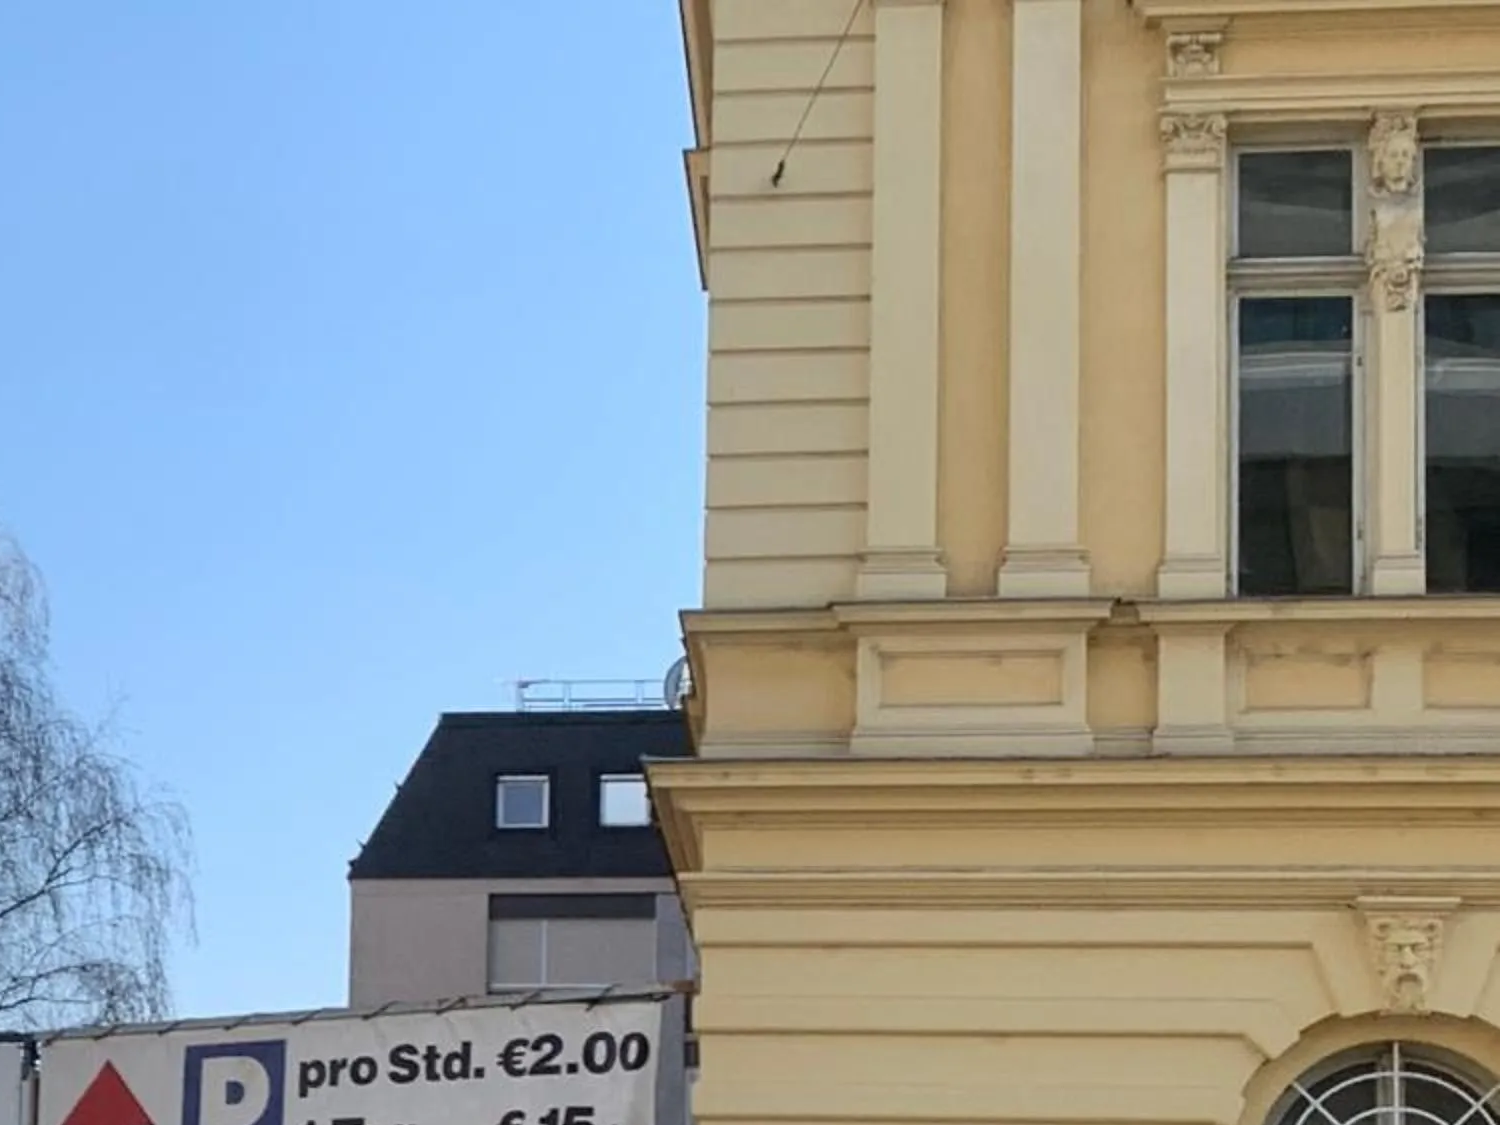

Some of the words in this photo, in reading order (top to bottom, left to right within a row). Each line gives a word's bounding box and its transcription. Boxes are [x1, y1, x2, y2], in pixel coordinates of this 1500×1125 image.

[298, 1056, 378, 1099] pro
[388, 1041, 486, 1084] Std.
[496, 1031, 650, 1078] €2.00
